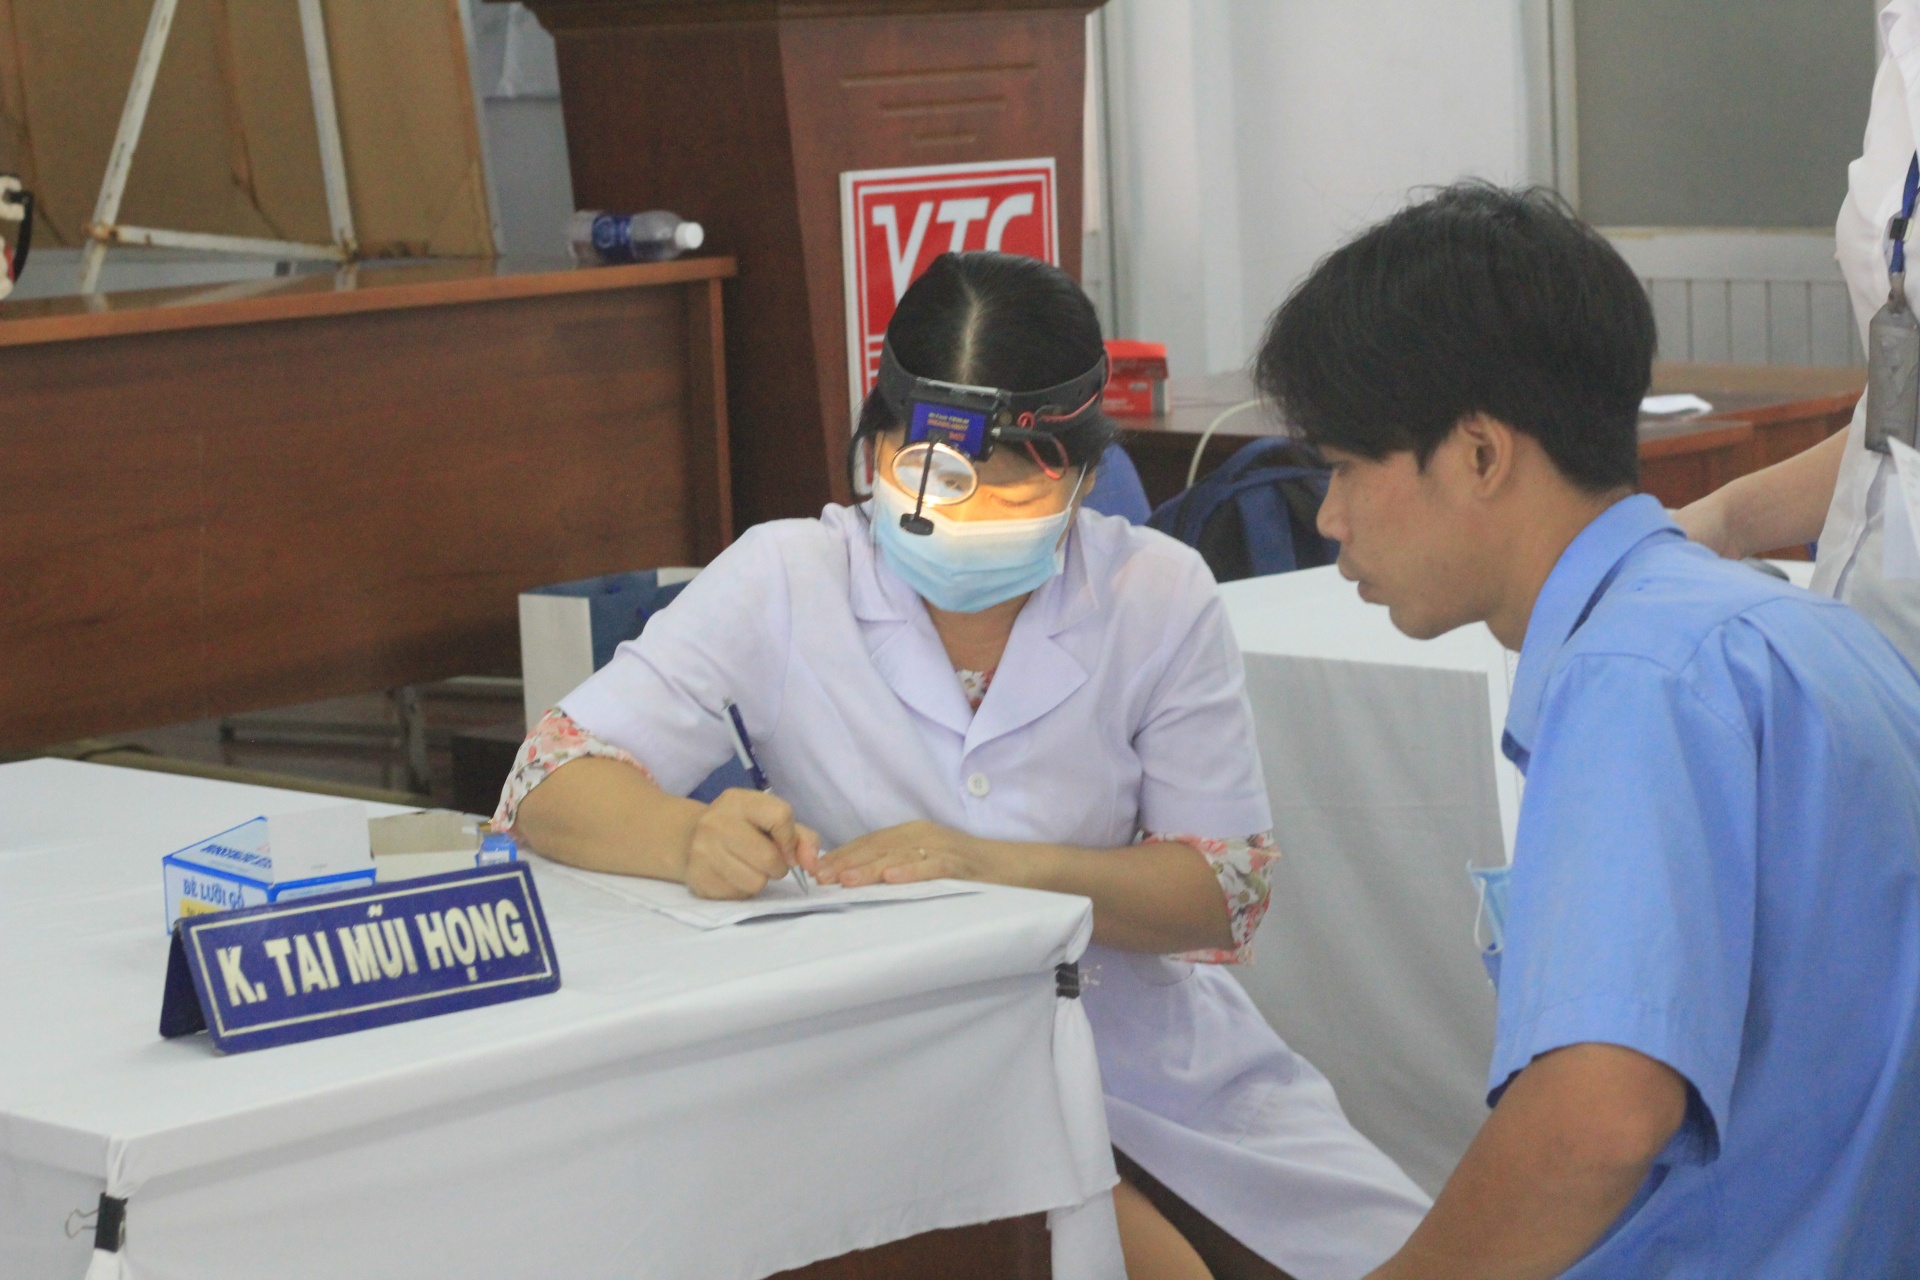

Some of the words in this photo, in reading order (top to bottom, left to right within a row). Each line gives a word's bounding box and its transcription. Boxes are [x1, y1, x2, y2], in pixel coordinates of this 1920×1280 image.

[216, 945, 268, 1007] K.
[264, 931, 340, 997] TAI
[337, 904, 419, 985] MŨI
[415, 899, 530, 981] HỌNG
